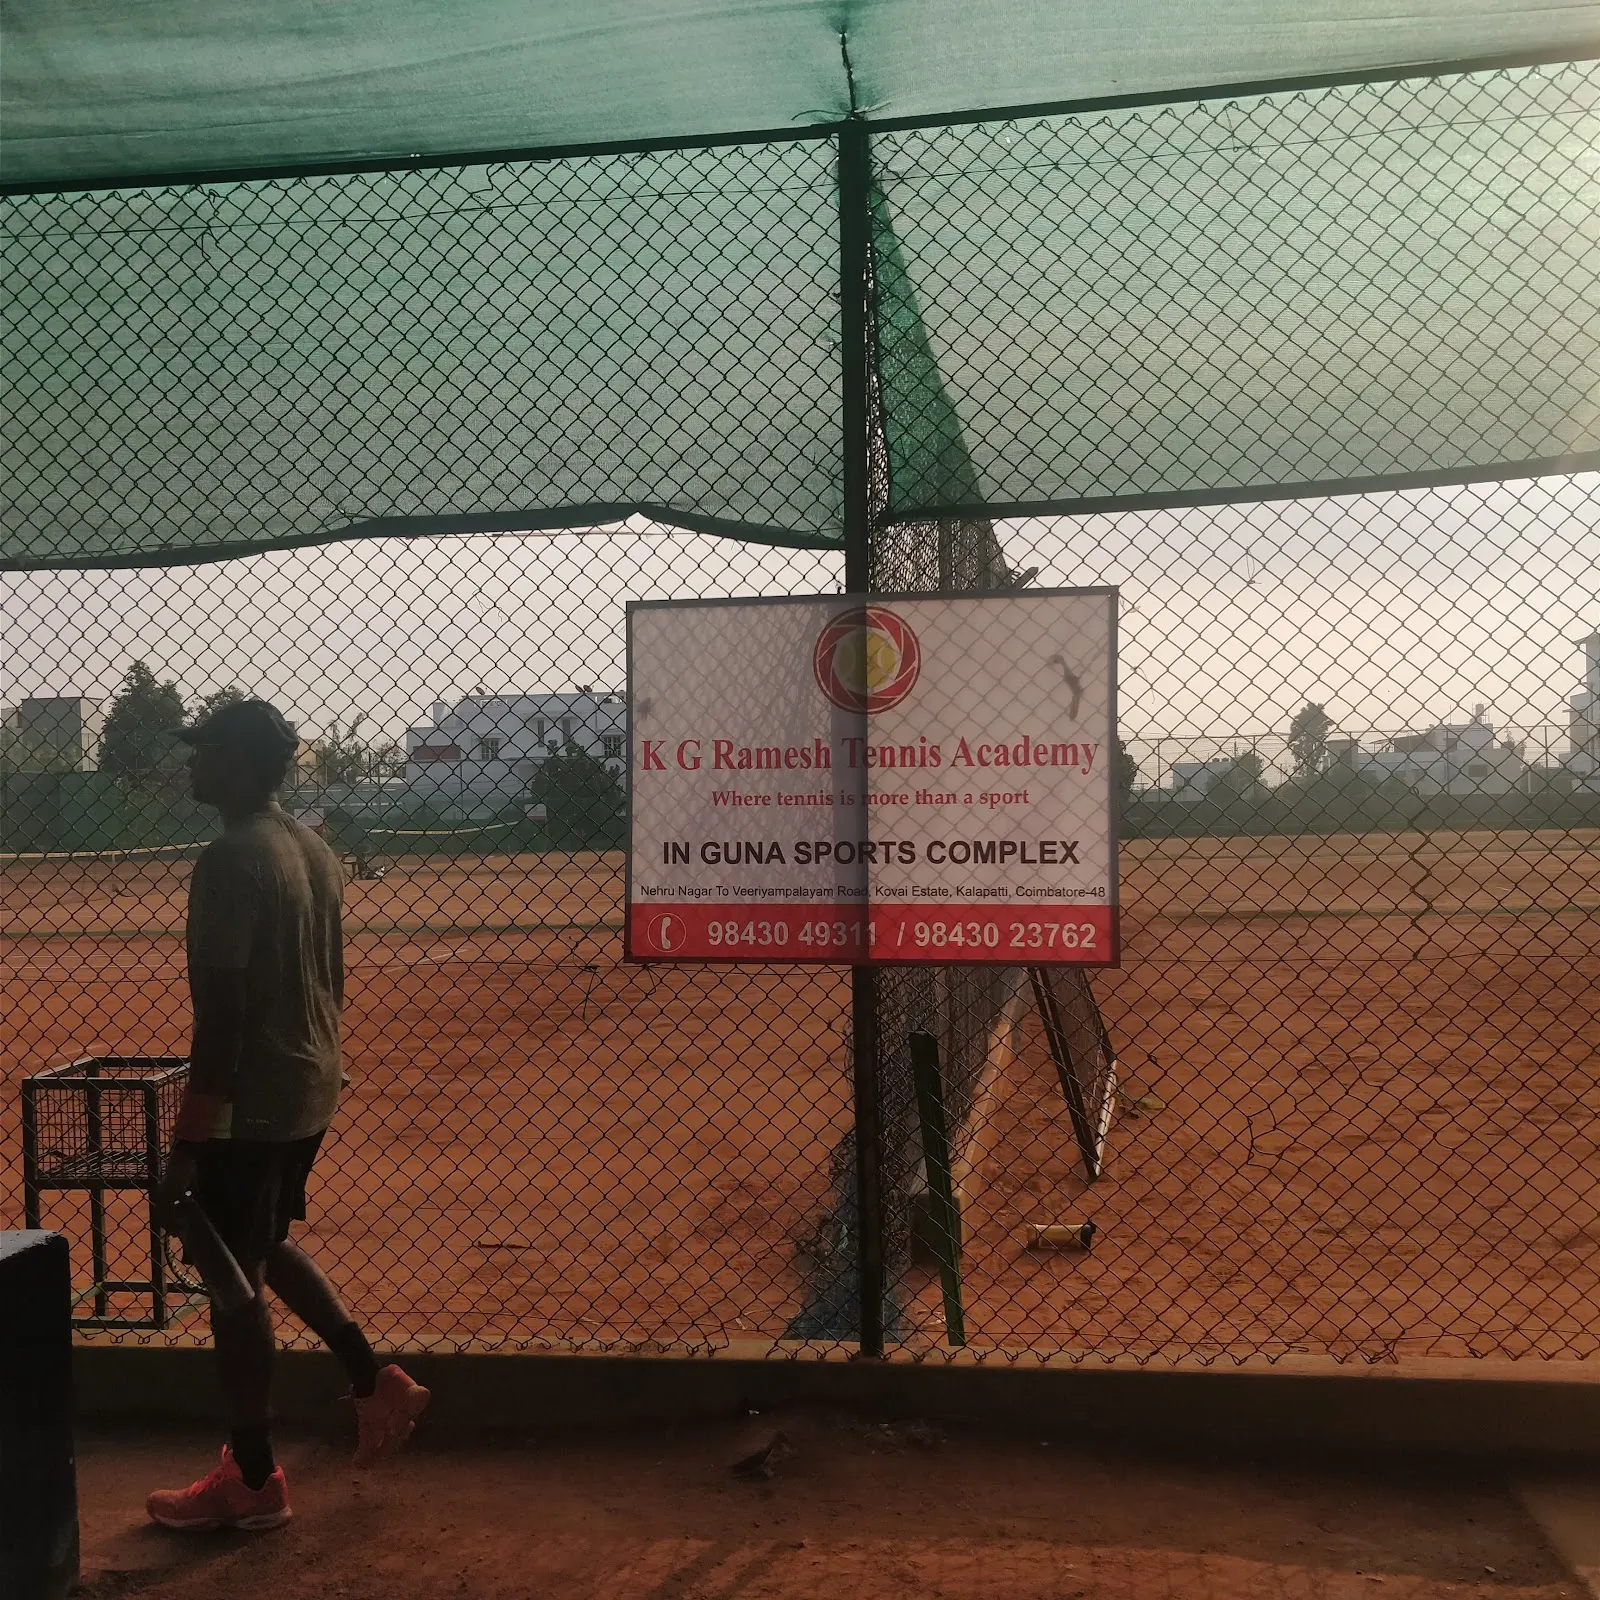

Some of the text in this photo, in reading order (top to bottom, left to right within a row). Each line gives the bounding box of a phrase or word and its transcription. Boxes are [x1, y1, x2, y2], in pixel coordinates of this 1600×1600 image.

[641, 735, 1099, 776] K G Ramesh Tennis Academy
[712, 789, 1030, 809] Where tennis is more than a sport
[663, 840, 1081, 865] IN GUNA SPORTS COMPLEX
[641, 885, 1106, 900] Nehru Nagar To Veeriyampalayam Road, Kovai Estate, Kalapatti, Coimbatore-48
[707, 921, 1097, 948] 98430 49311 / 98430 23762
